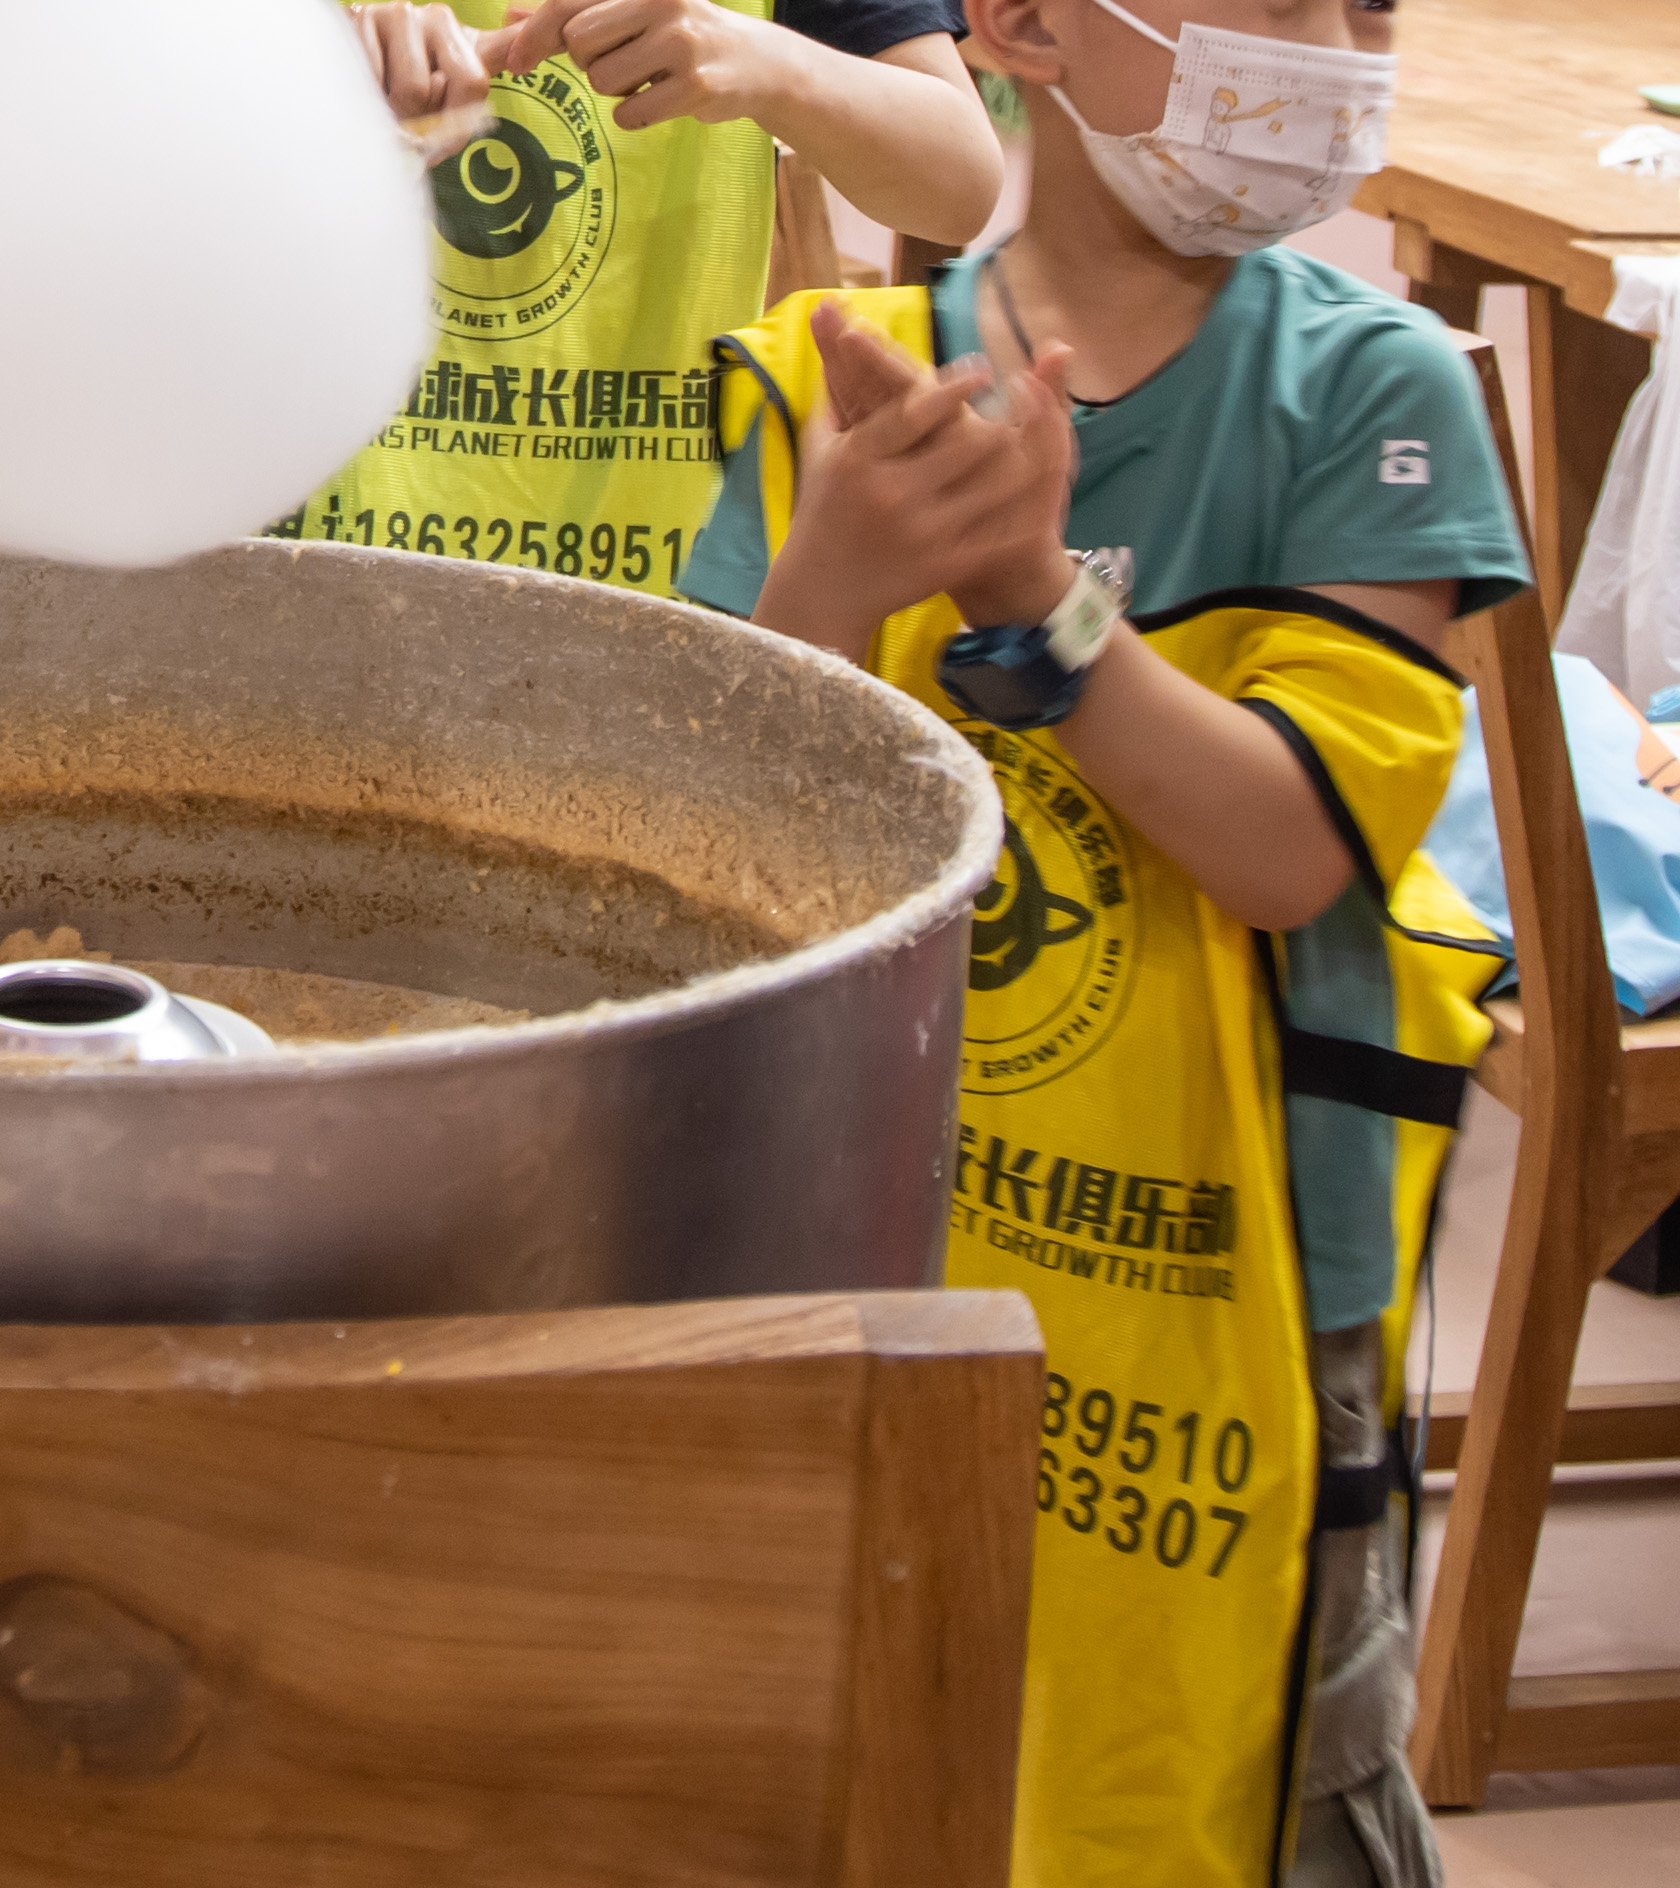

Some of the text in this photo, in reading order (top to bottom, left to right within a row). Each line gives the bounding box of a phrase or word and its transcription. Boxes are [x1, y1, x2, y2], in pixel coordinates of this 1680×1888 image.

[517, 253, 589, 324] GROWTH
[585, 188, 602, 247] CLUB
[412, 426, 527, 458] PLANET
[533, 434, 656, 461] GROWTH
[988, 1217, 1152, 1292] GROWTH
[1042, 1372, 1253, 1494] 89510
[1037, 1448, 1248, 1579] 63307
